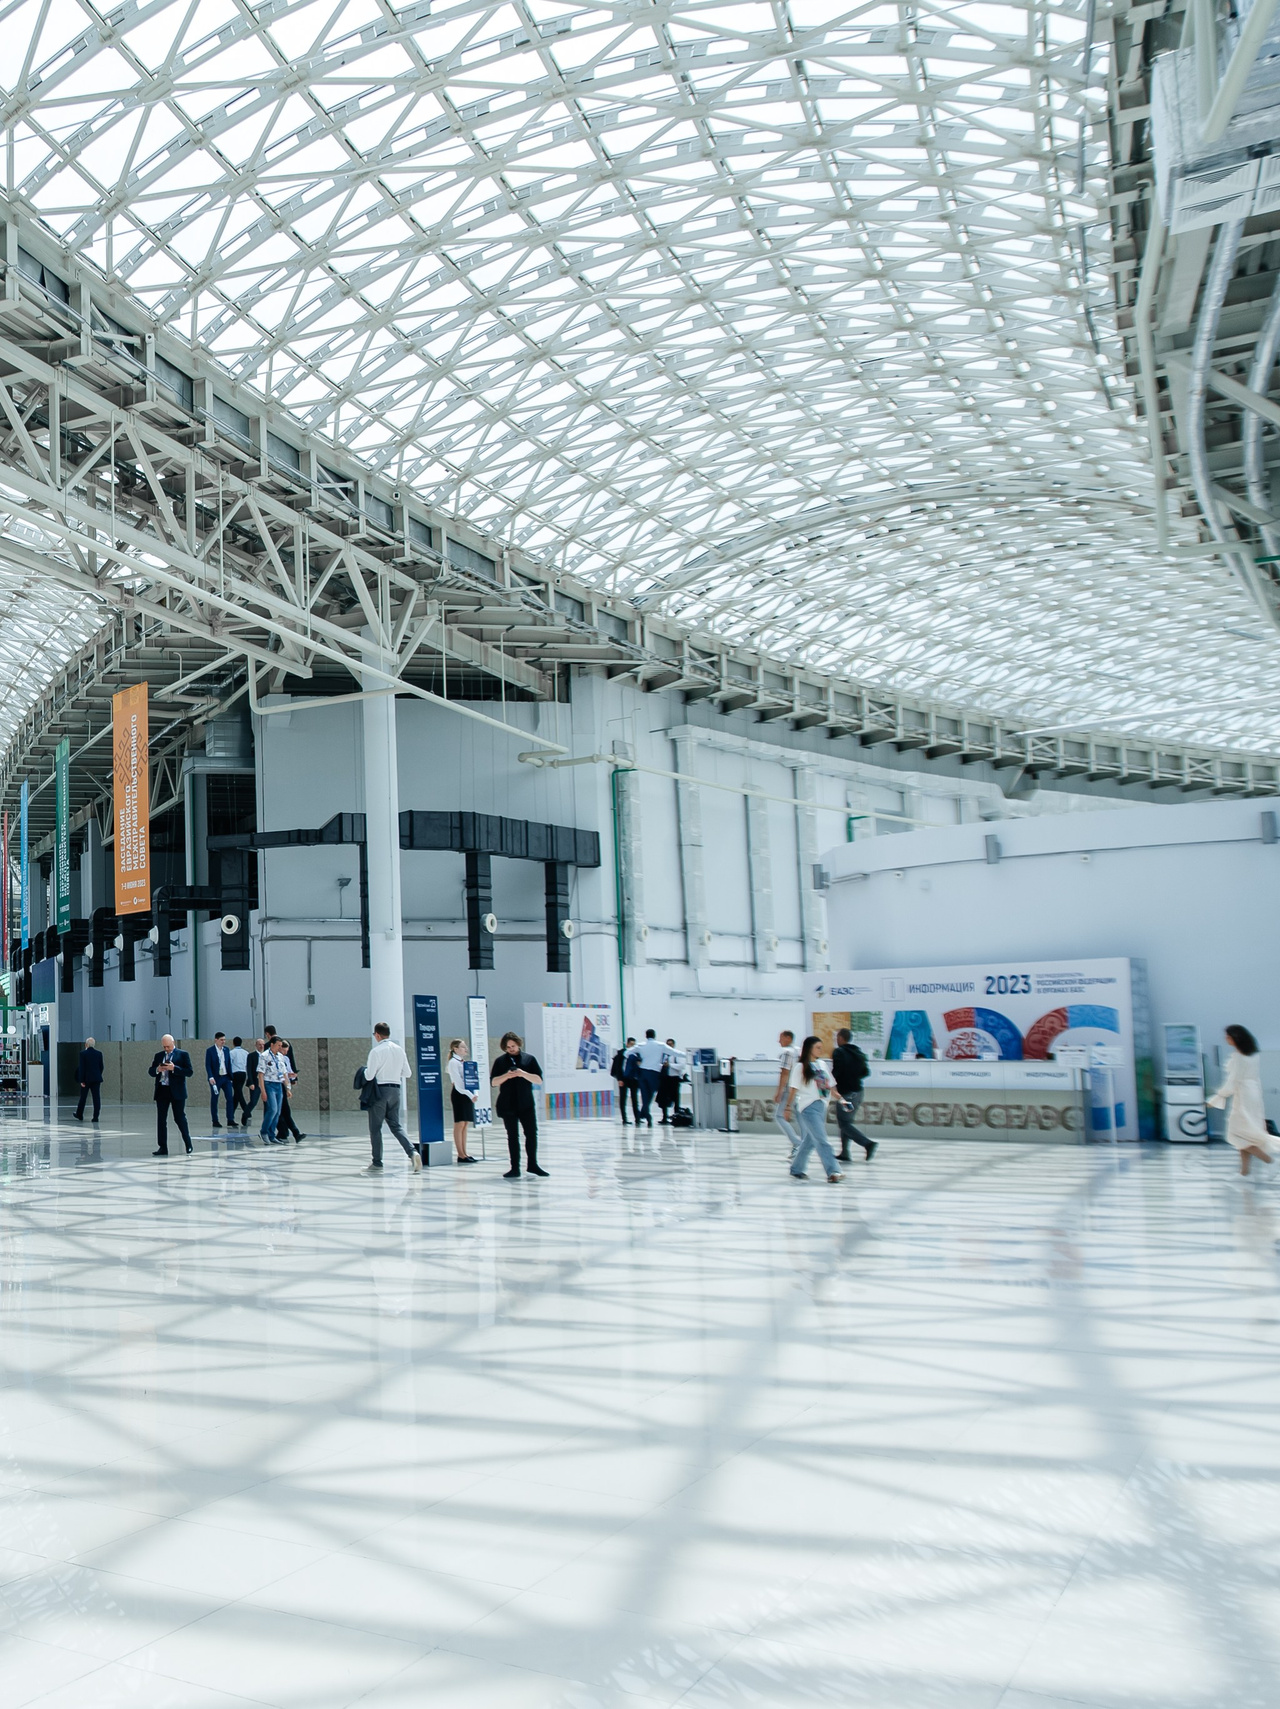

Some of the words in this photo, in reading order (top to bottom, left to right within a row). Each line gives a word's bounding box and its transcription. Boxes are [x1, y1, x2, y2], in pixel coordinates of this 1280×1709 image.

[130, 713, 138, 870] МЕЖПРАВИТЕЛЬСТВЕННОГО
[909, 982, 975, 993] ИНФОРМАЦИЯ
[985, 974, 1031, 995] 2023
